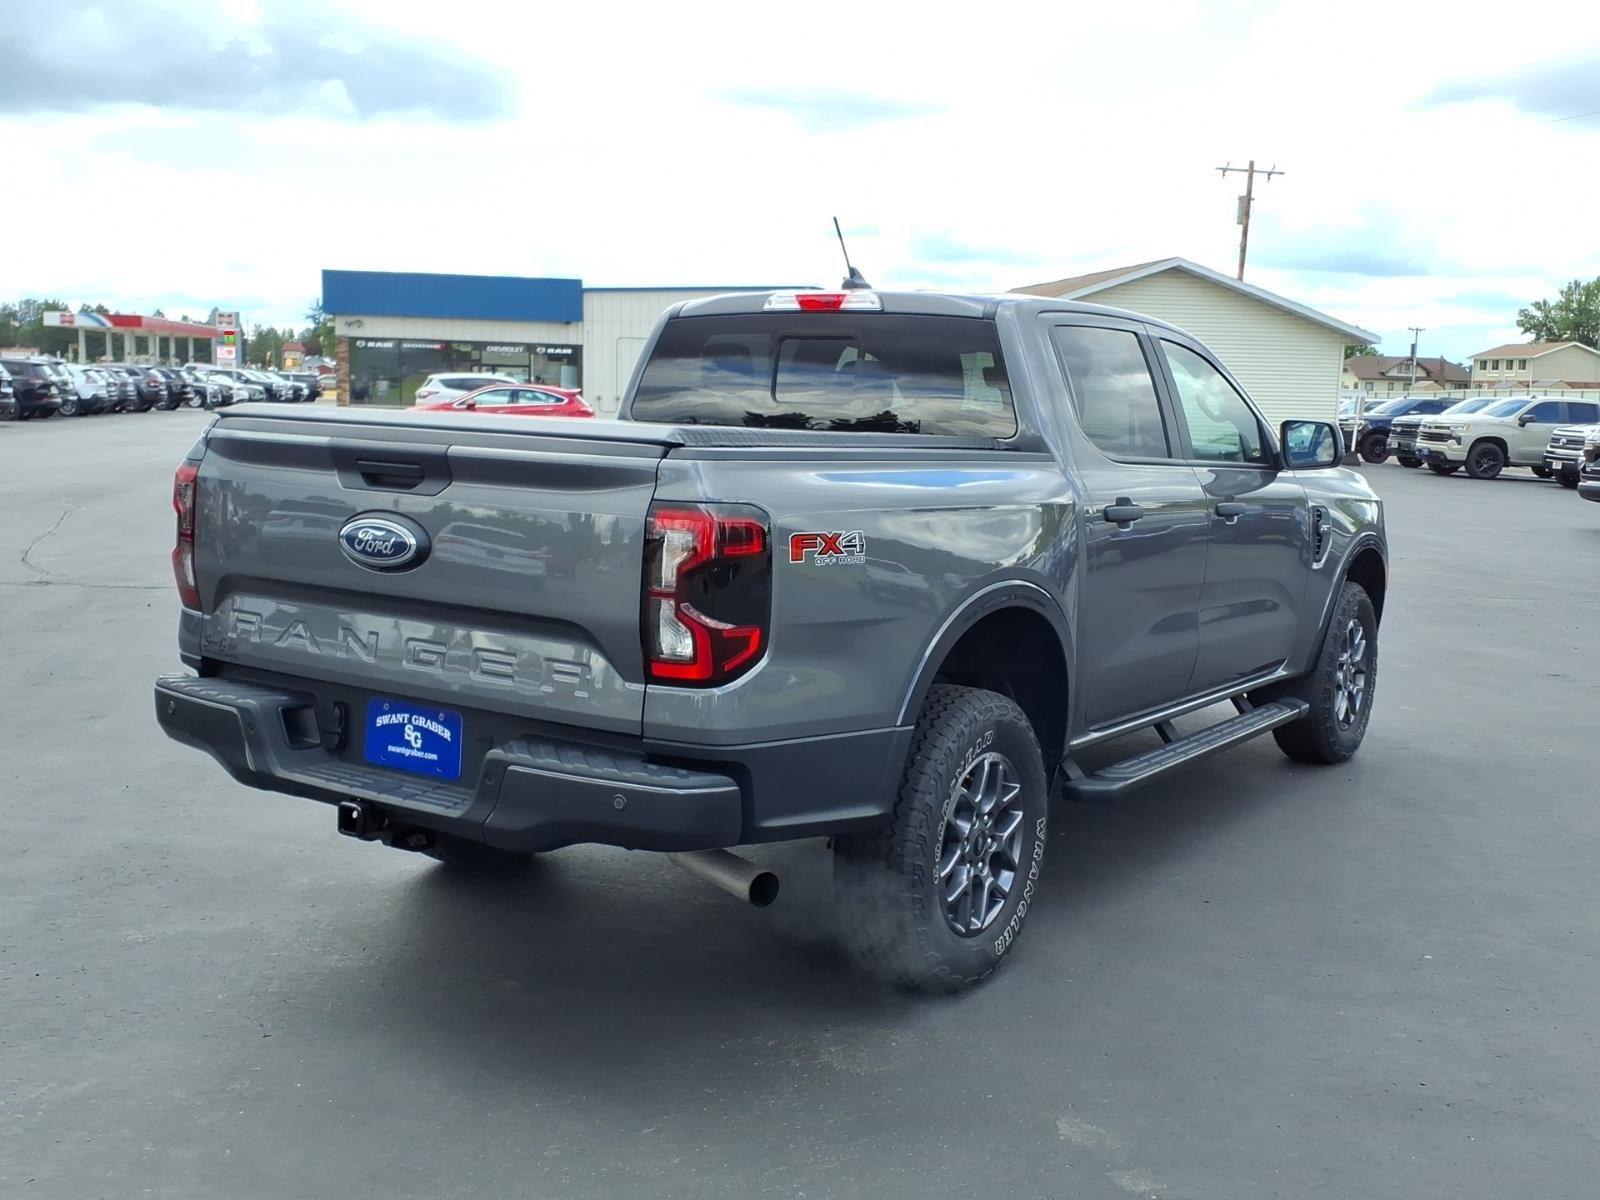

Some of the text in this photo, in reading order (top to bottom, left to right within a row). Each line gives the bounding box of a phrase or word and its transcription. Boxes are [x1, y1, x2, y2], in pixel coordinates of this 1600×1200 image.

[354, 527, 395, 555] Ford
[789, 530, 866, 564] FX4
[815, 556, 866, 566] OFF ROAD
[227, 606, 592, 698] RANGER
[376, 714, 452, 742] SWANT GRABER
[387, 745, 438, 760] swantgraber.com
[994, 817, 1047, 956] WRANGLER
